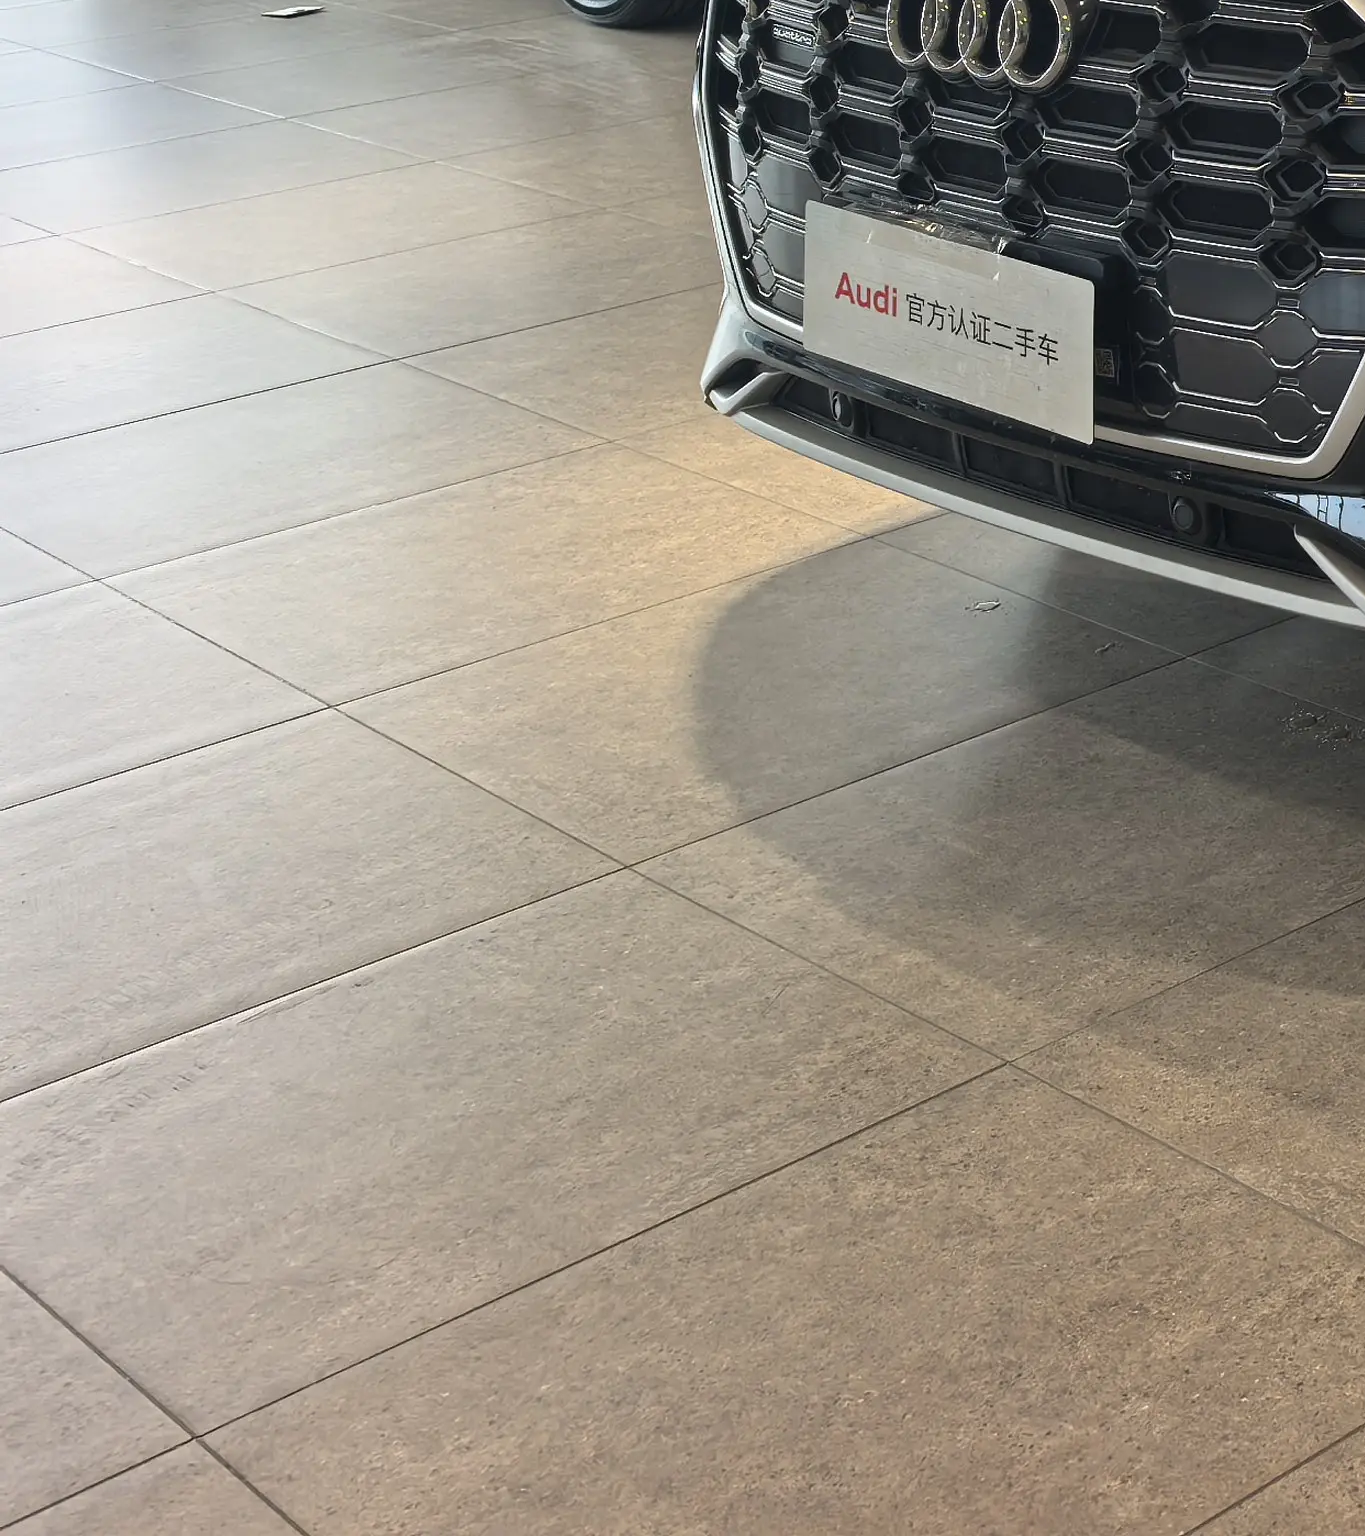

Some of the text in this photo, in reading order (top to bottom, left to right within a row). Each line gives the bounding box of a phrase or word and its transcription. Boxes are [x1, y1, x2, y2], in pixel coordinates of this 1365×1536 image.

[834, 272, 1059, 366] Audi 官方认证二手车
